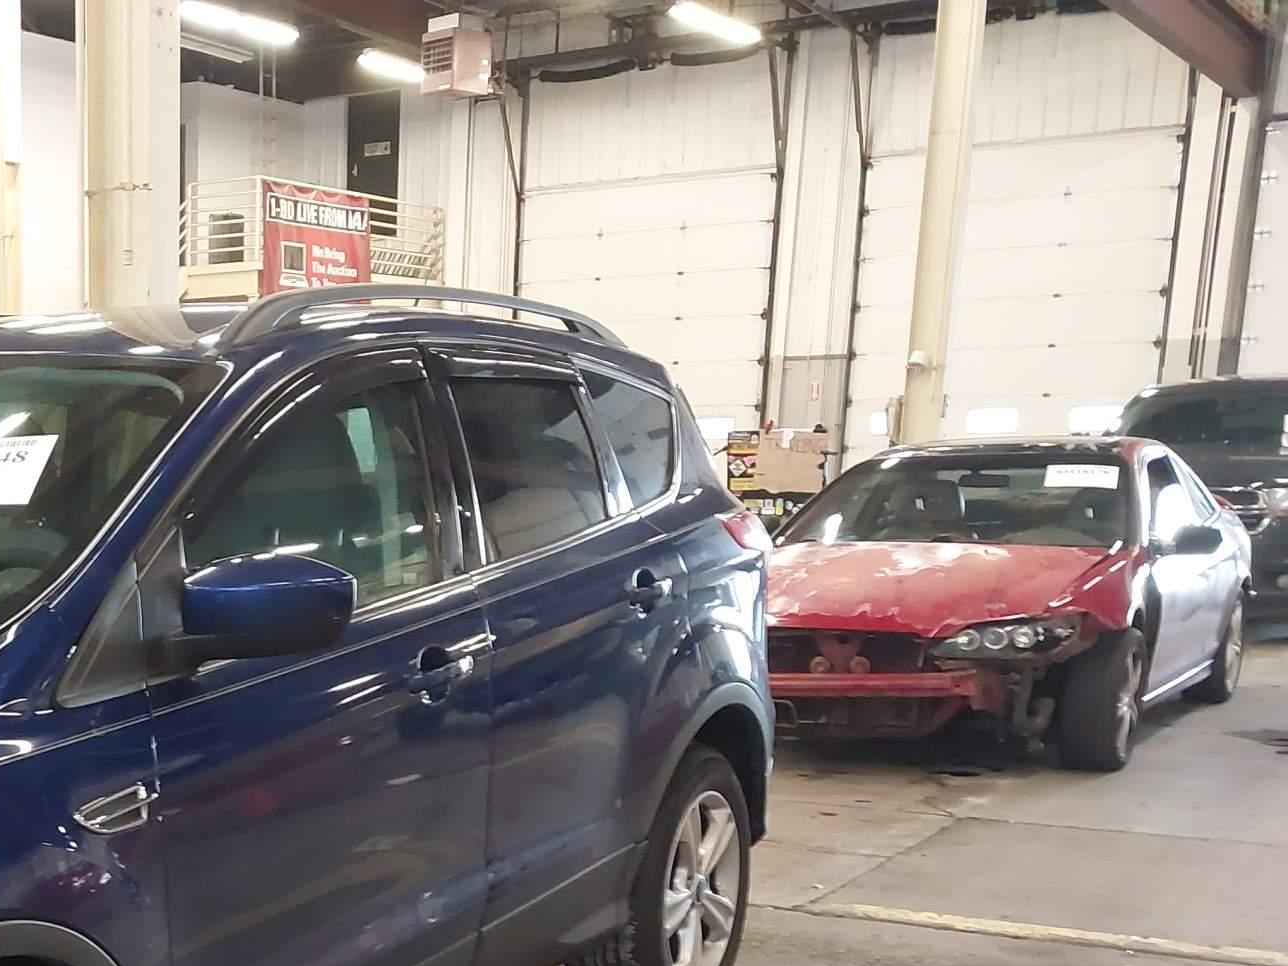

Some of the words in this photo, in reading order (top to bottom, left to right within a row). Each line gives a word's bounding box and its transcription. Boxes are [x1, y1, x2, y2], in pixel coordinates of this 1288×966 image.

[296, 203, 318, 224] LIVE
[319, 206, 347, 228] FROM
[311, 261, 326, 274] The
[326, 262, 358, 278] Auction
